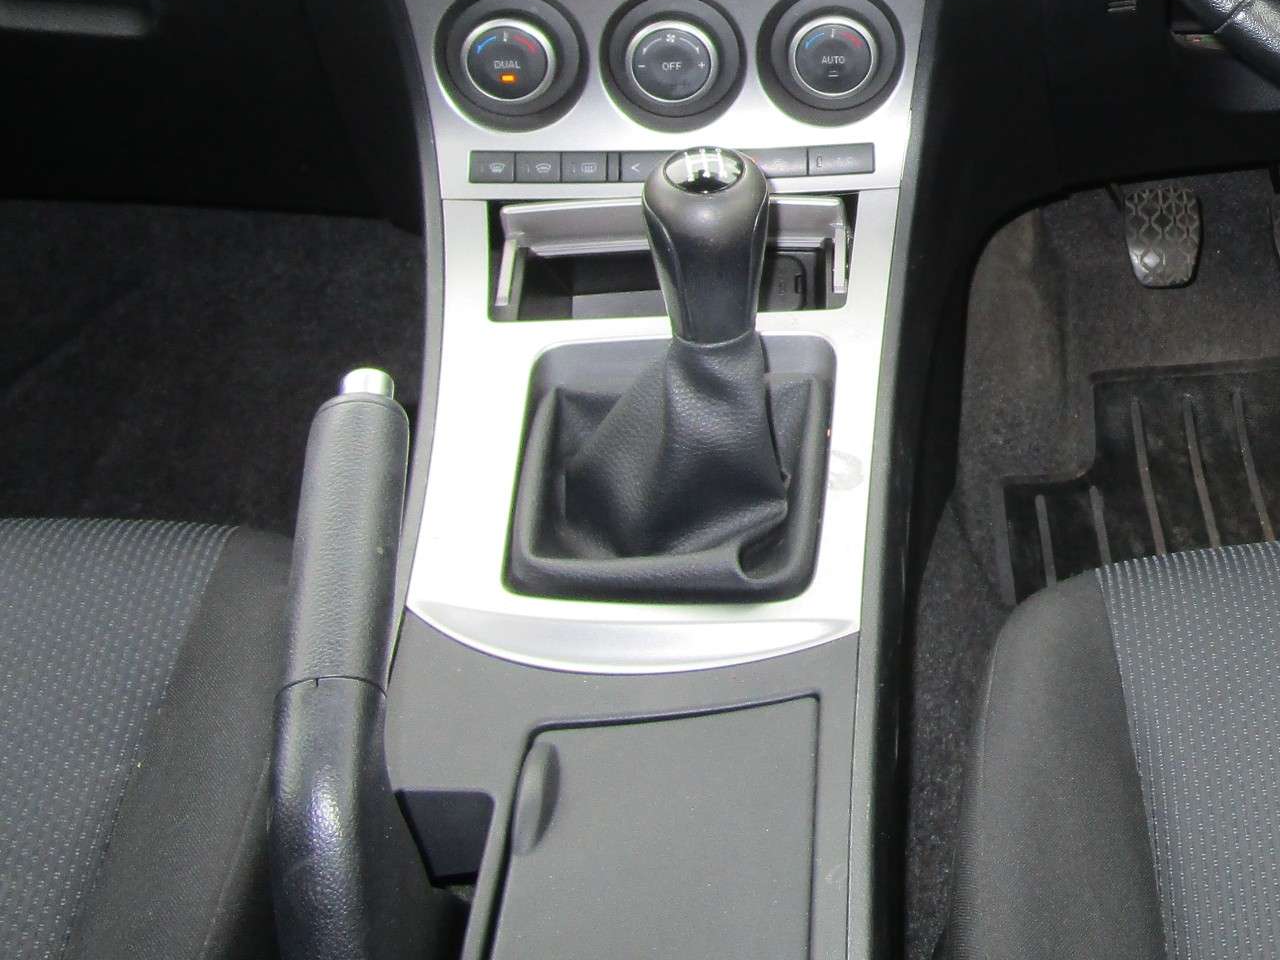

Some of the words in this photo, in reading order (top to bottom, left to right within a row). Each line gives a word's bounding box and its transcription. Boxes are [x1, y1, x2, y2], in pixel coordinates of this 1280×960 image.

[494, 60, 521, 69] DUAL
[821, 55, 846, 65] AUTO
[662, 62, 682, 71] OFF
